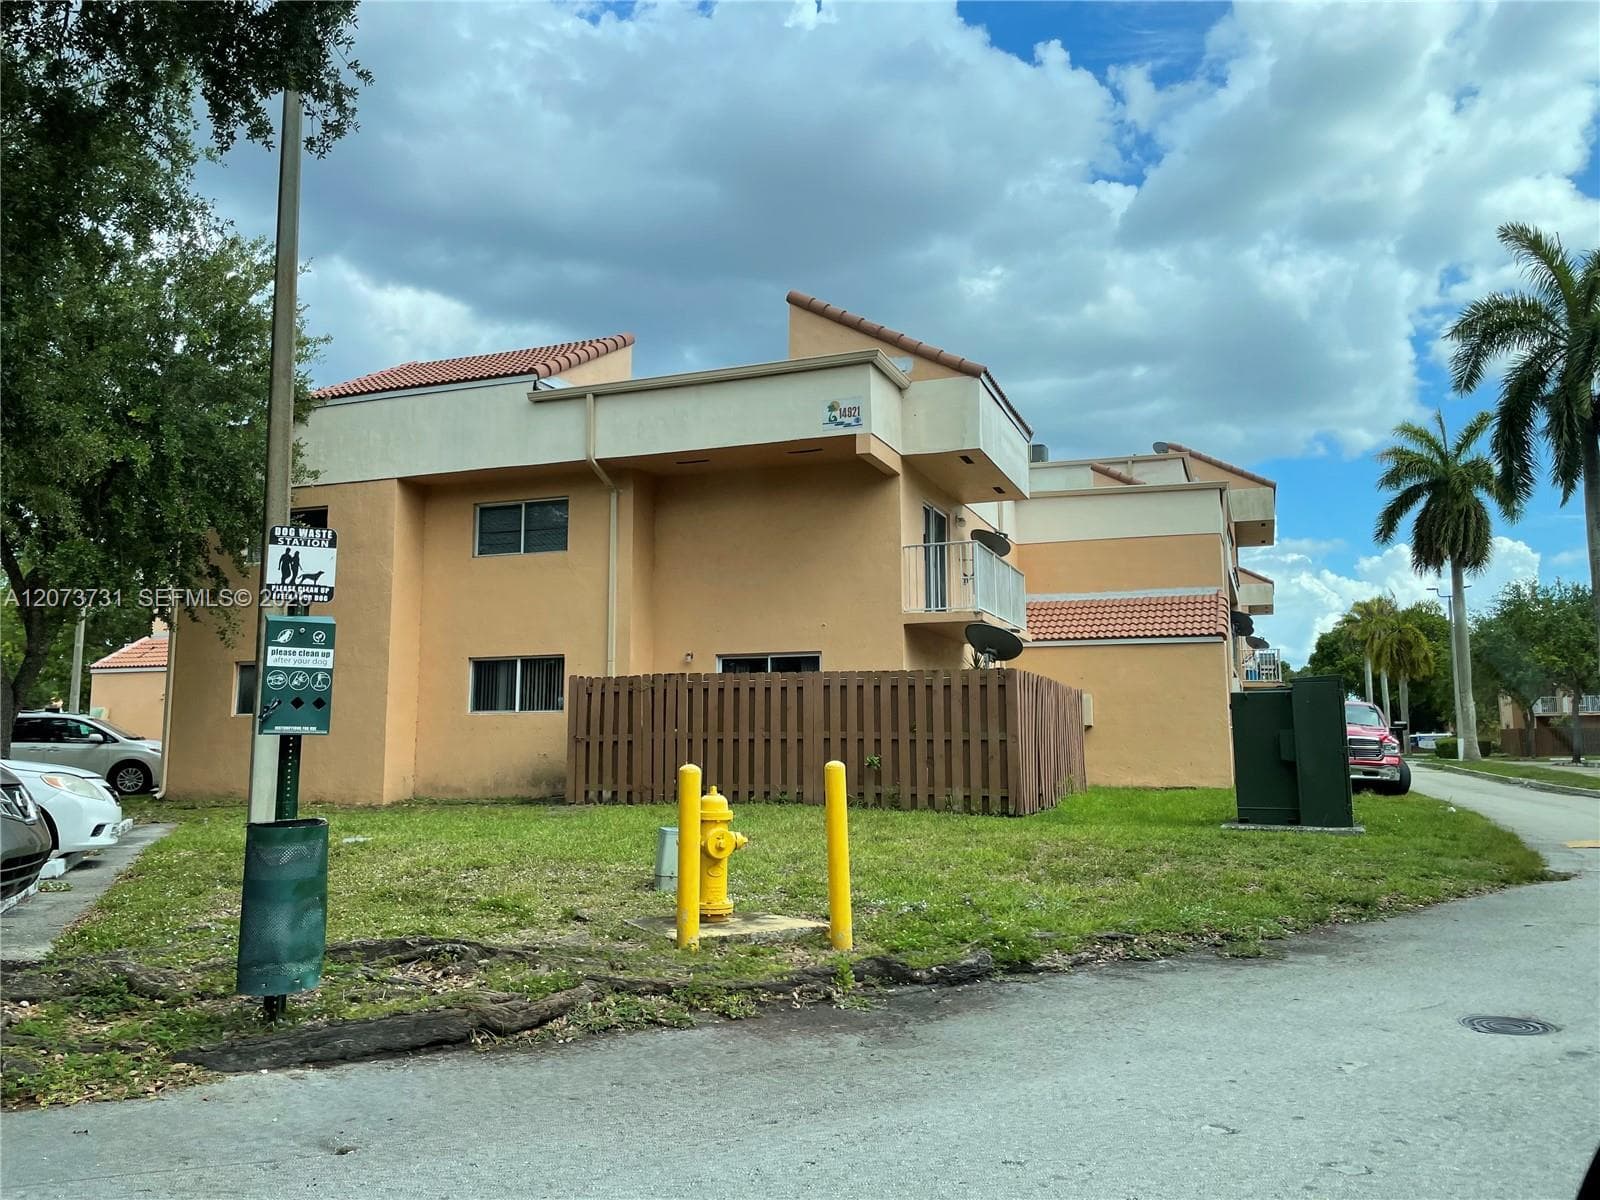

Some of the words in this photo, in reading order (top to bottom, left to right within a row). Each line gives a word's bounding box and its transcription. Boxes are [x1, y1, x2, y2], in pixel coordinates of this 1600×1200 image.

[274, 527, 295, 537] DOG
[299, 529, 333, 539] WASTE
[277, 537, 329, 547] STATION
[298, 650, 320, 658] clean
[321, 651, 331, 659] up
[312, 658, 328, 666] dog
